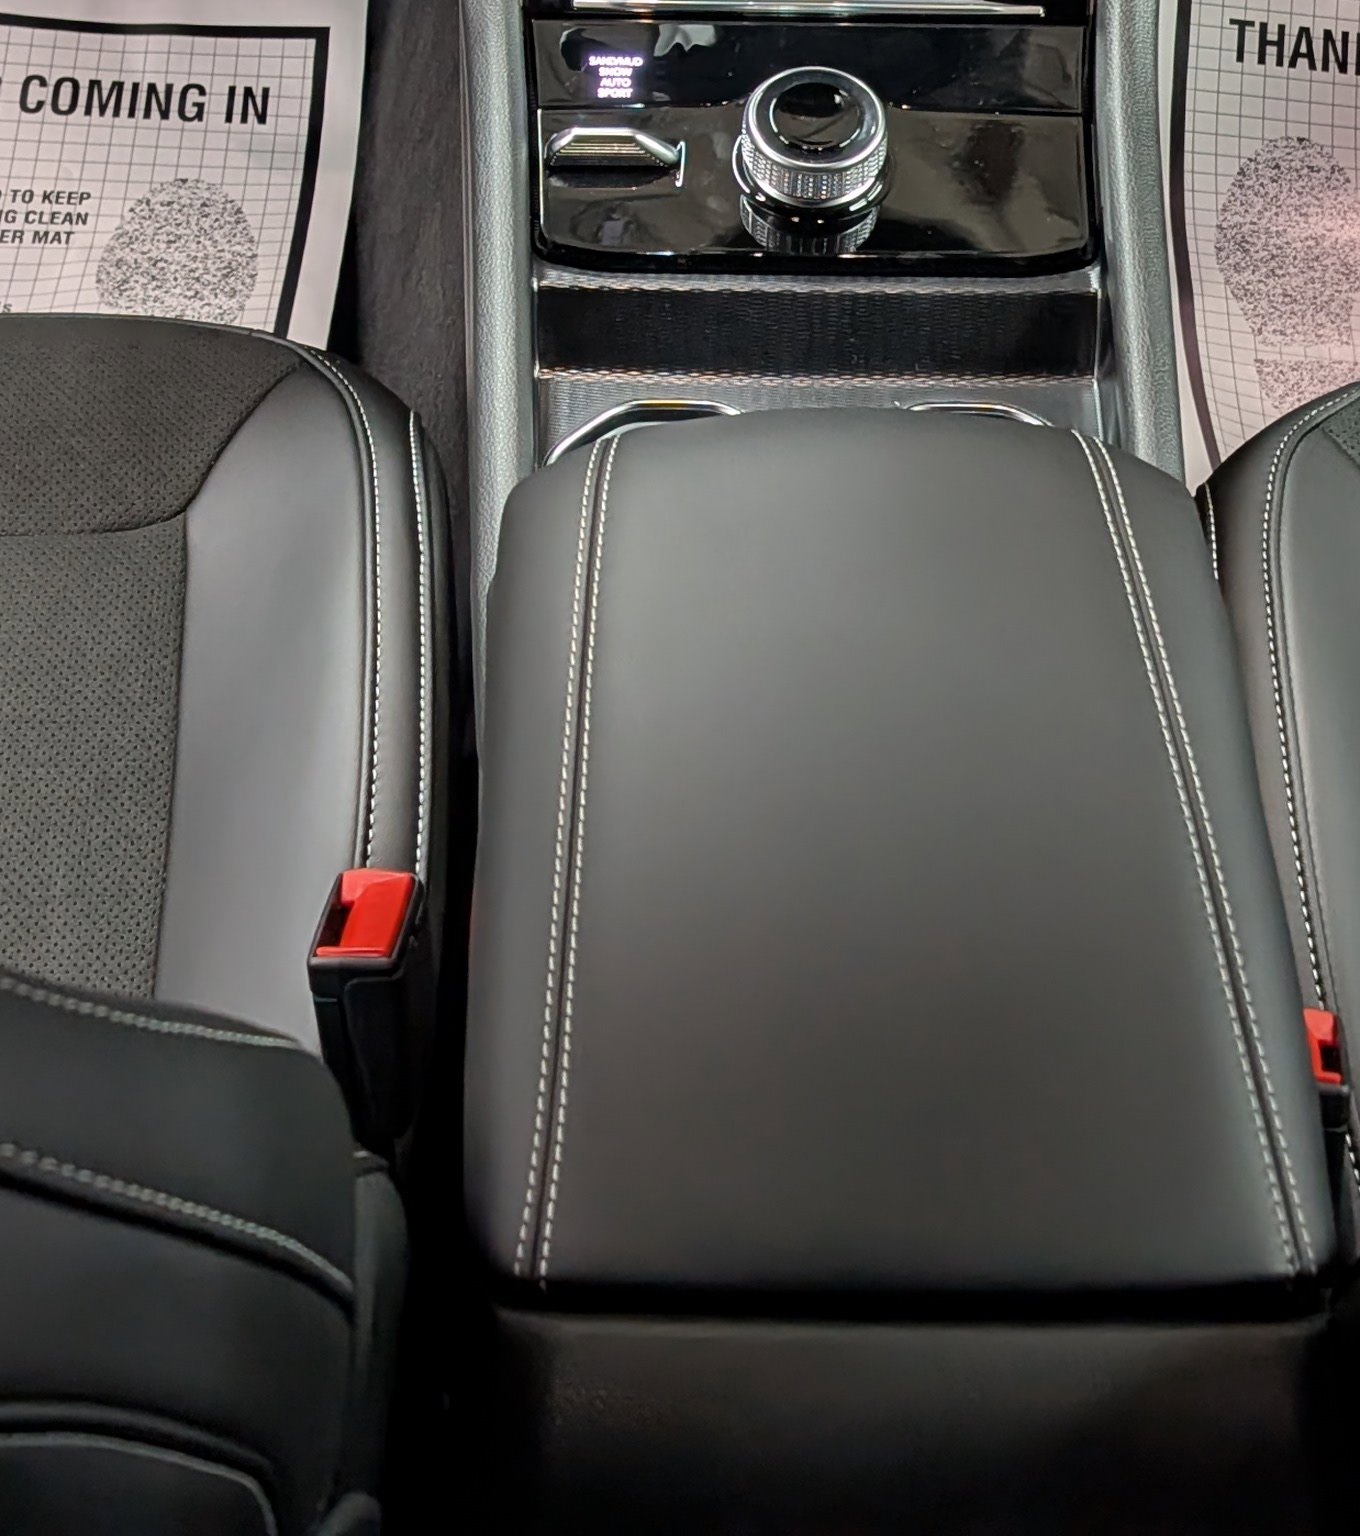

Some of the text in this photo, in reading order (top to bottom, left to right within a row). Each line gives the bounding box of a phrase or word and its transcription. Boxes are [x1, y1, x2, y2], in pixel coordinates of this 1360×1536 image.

[598, 66, 633, 77] SNOW
[600, 77, 632, 87] AUTO
[19, 74, 207, 123] COMING
[224, 85, 270, 125] IN
[597, 87, 634, 99] SPORT
[10, 189, 34, 204] TO
[41, 190, 92, 206] KEEP
[24, 210, 89, 226] CLEAN
[31, 230, 75, 245] MAT
